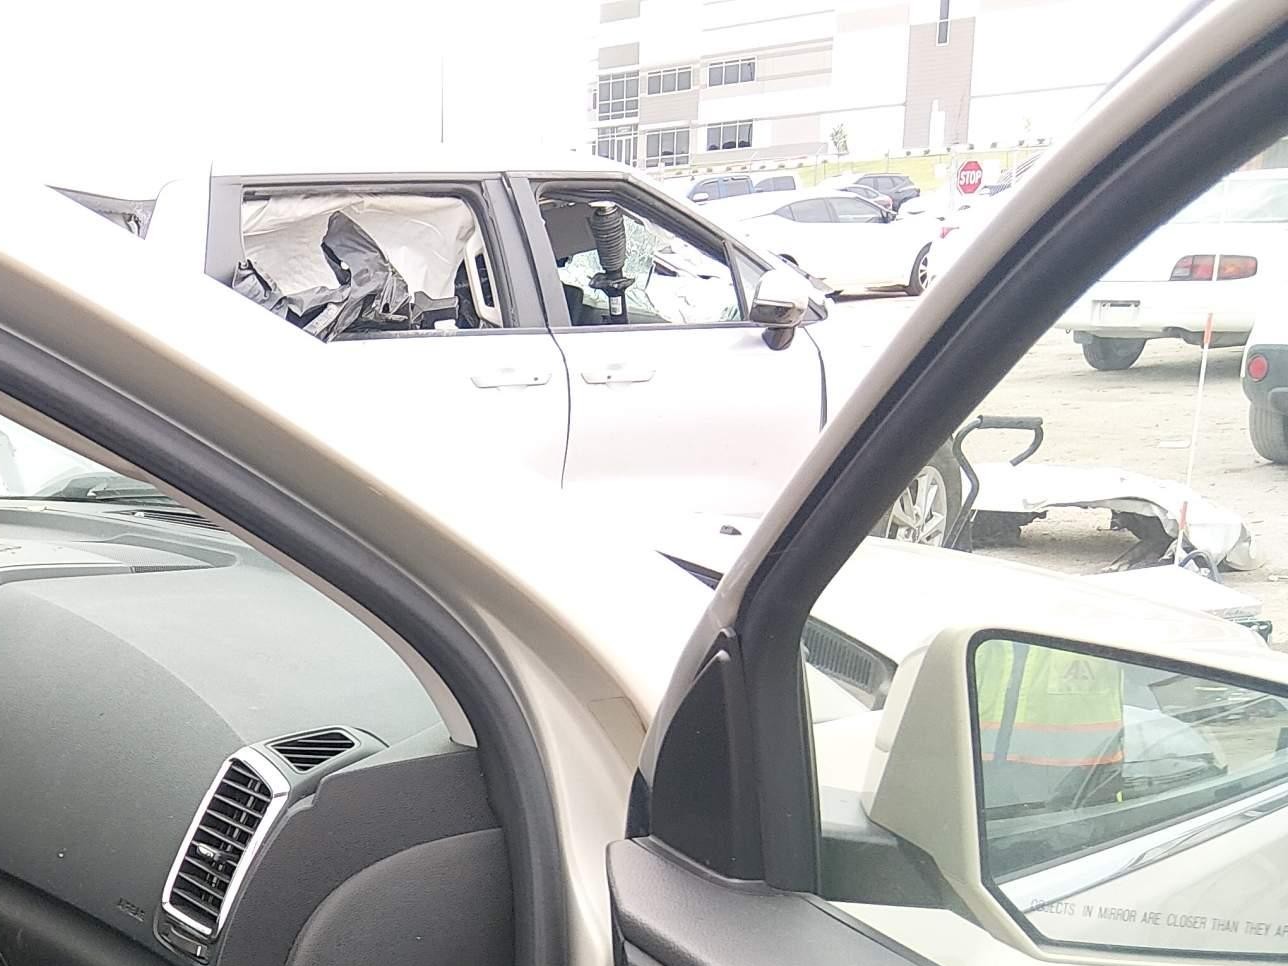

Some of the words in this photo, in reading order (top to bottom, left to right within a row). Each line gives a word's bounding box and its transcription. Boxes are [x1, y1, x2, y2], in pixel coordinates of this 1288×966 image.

[959, 170, 982, 185] STOP
[1082, 905, 1093, 917] IN
[1098, 907, 1137, 923] MIRROR
[1141, 911, 1161, 926] ARE
[1166, 913, 1207, 929] CLOSER
[1211, 918, 1239, 933] THAN
[1245, 921, 1272, 936] THEY
